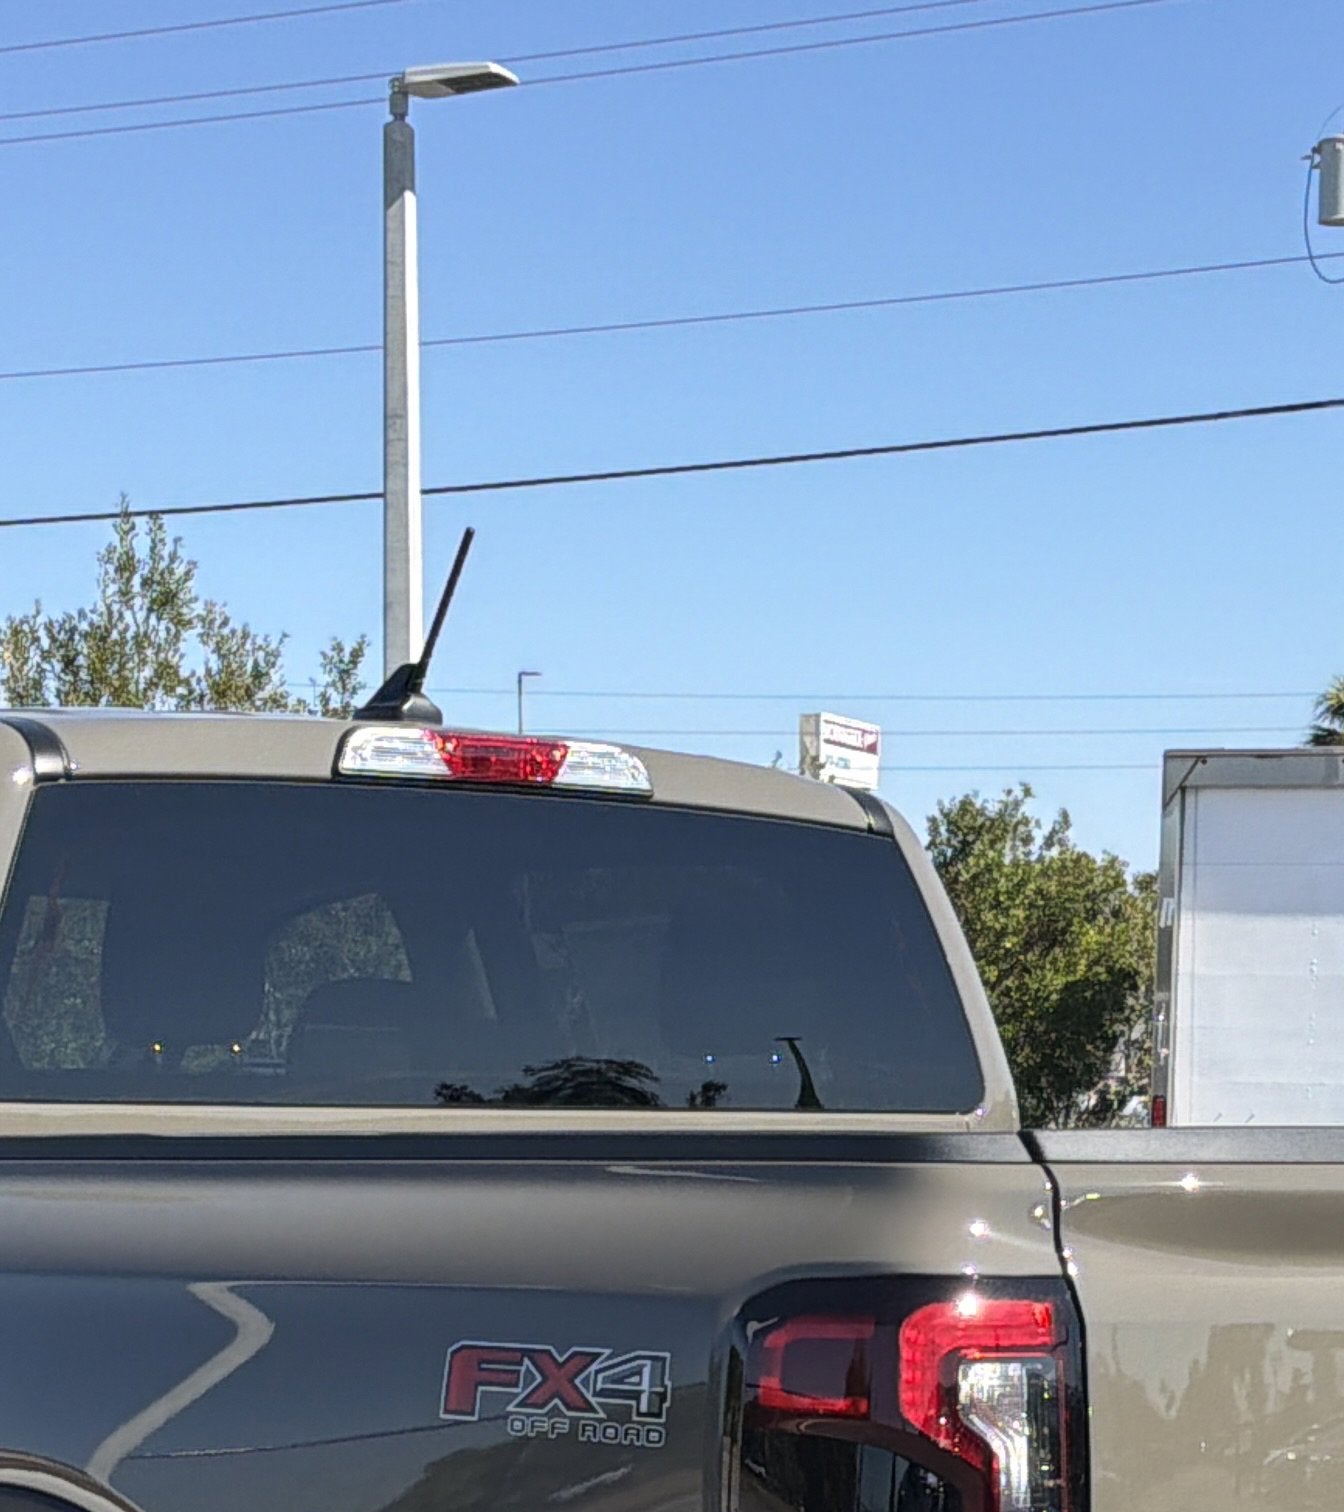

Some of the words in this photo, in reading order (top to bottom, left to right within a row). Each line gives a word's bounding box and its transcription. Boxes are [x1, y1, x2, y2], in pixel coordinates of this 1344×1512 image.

[439, 1340, 671, 1422] FX4
[507, 1415, 569, 1439] OFF
[578, 1420, 666, 1447] ROAD
